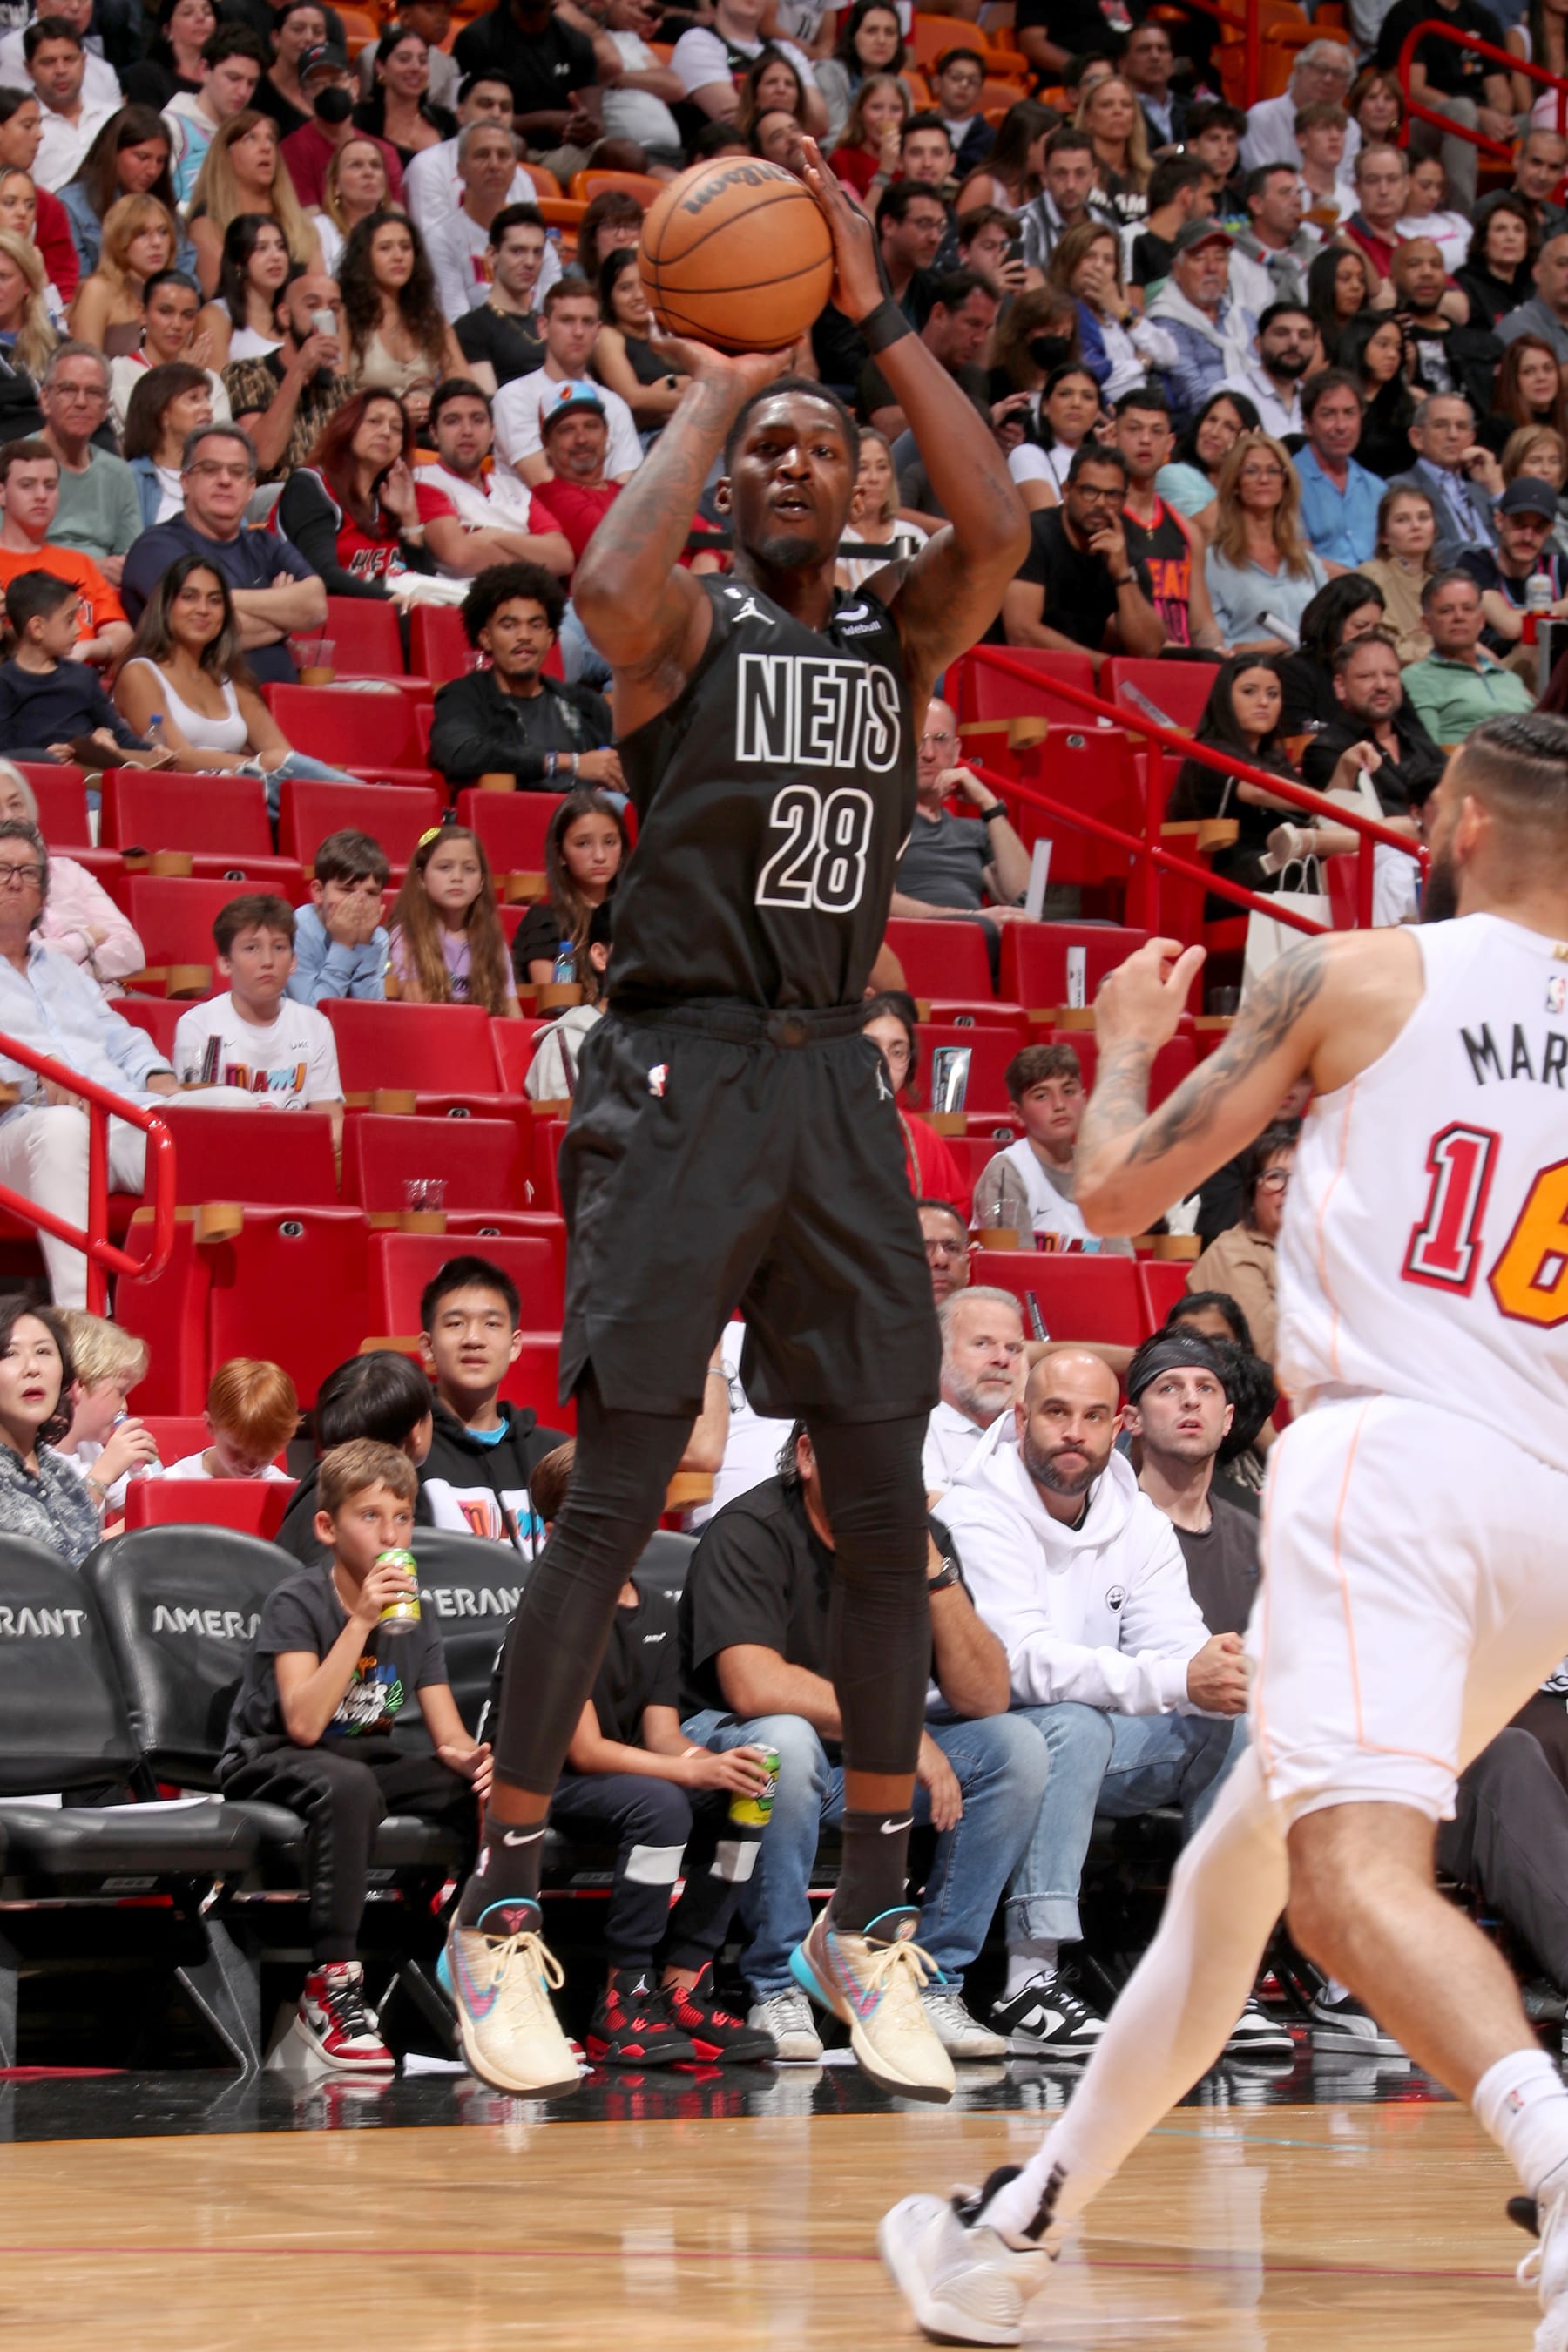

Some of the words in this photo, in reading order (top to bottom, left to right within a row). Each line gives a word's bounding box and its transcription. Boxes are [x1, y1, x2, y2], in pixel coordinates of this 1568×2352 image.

[842, 620, 882, 636] Webull
[736, 653, 901, 773] NETS
[754, 784, 874, 914] 28
[1459, 1021, 1568, 1090] MAR
[420, 1586, 524, 1617] ERAN
